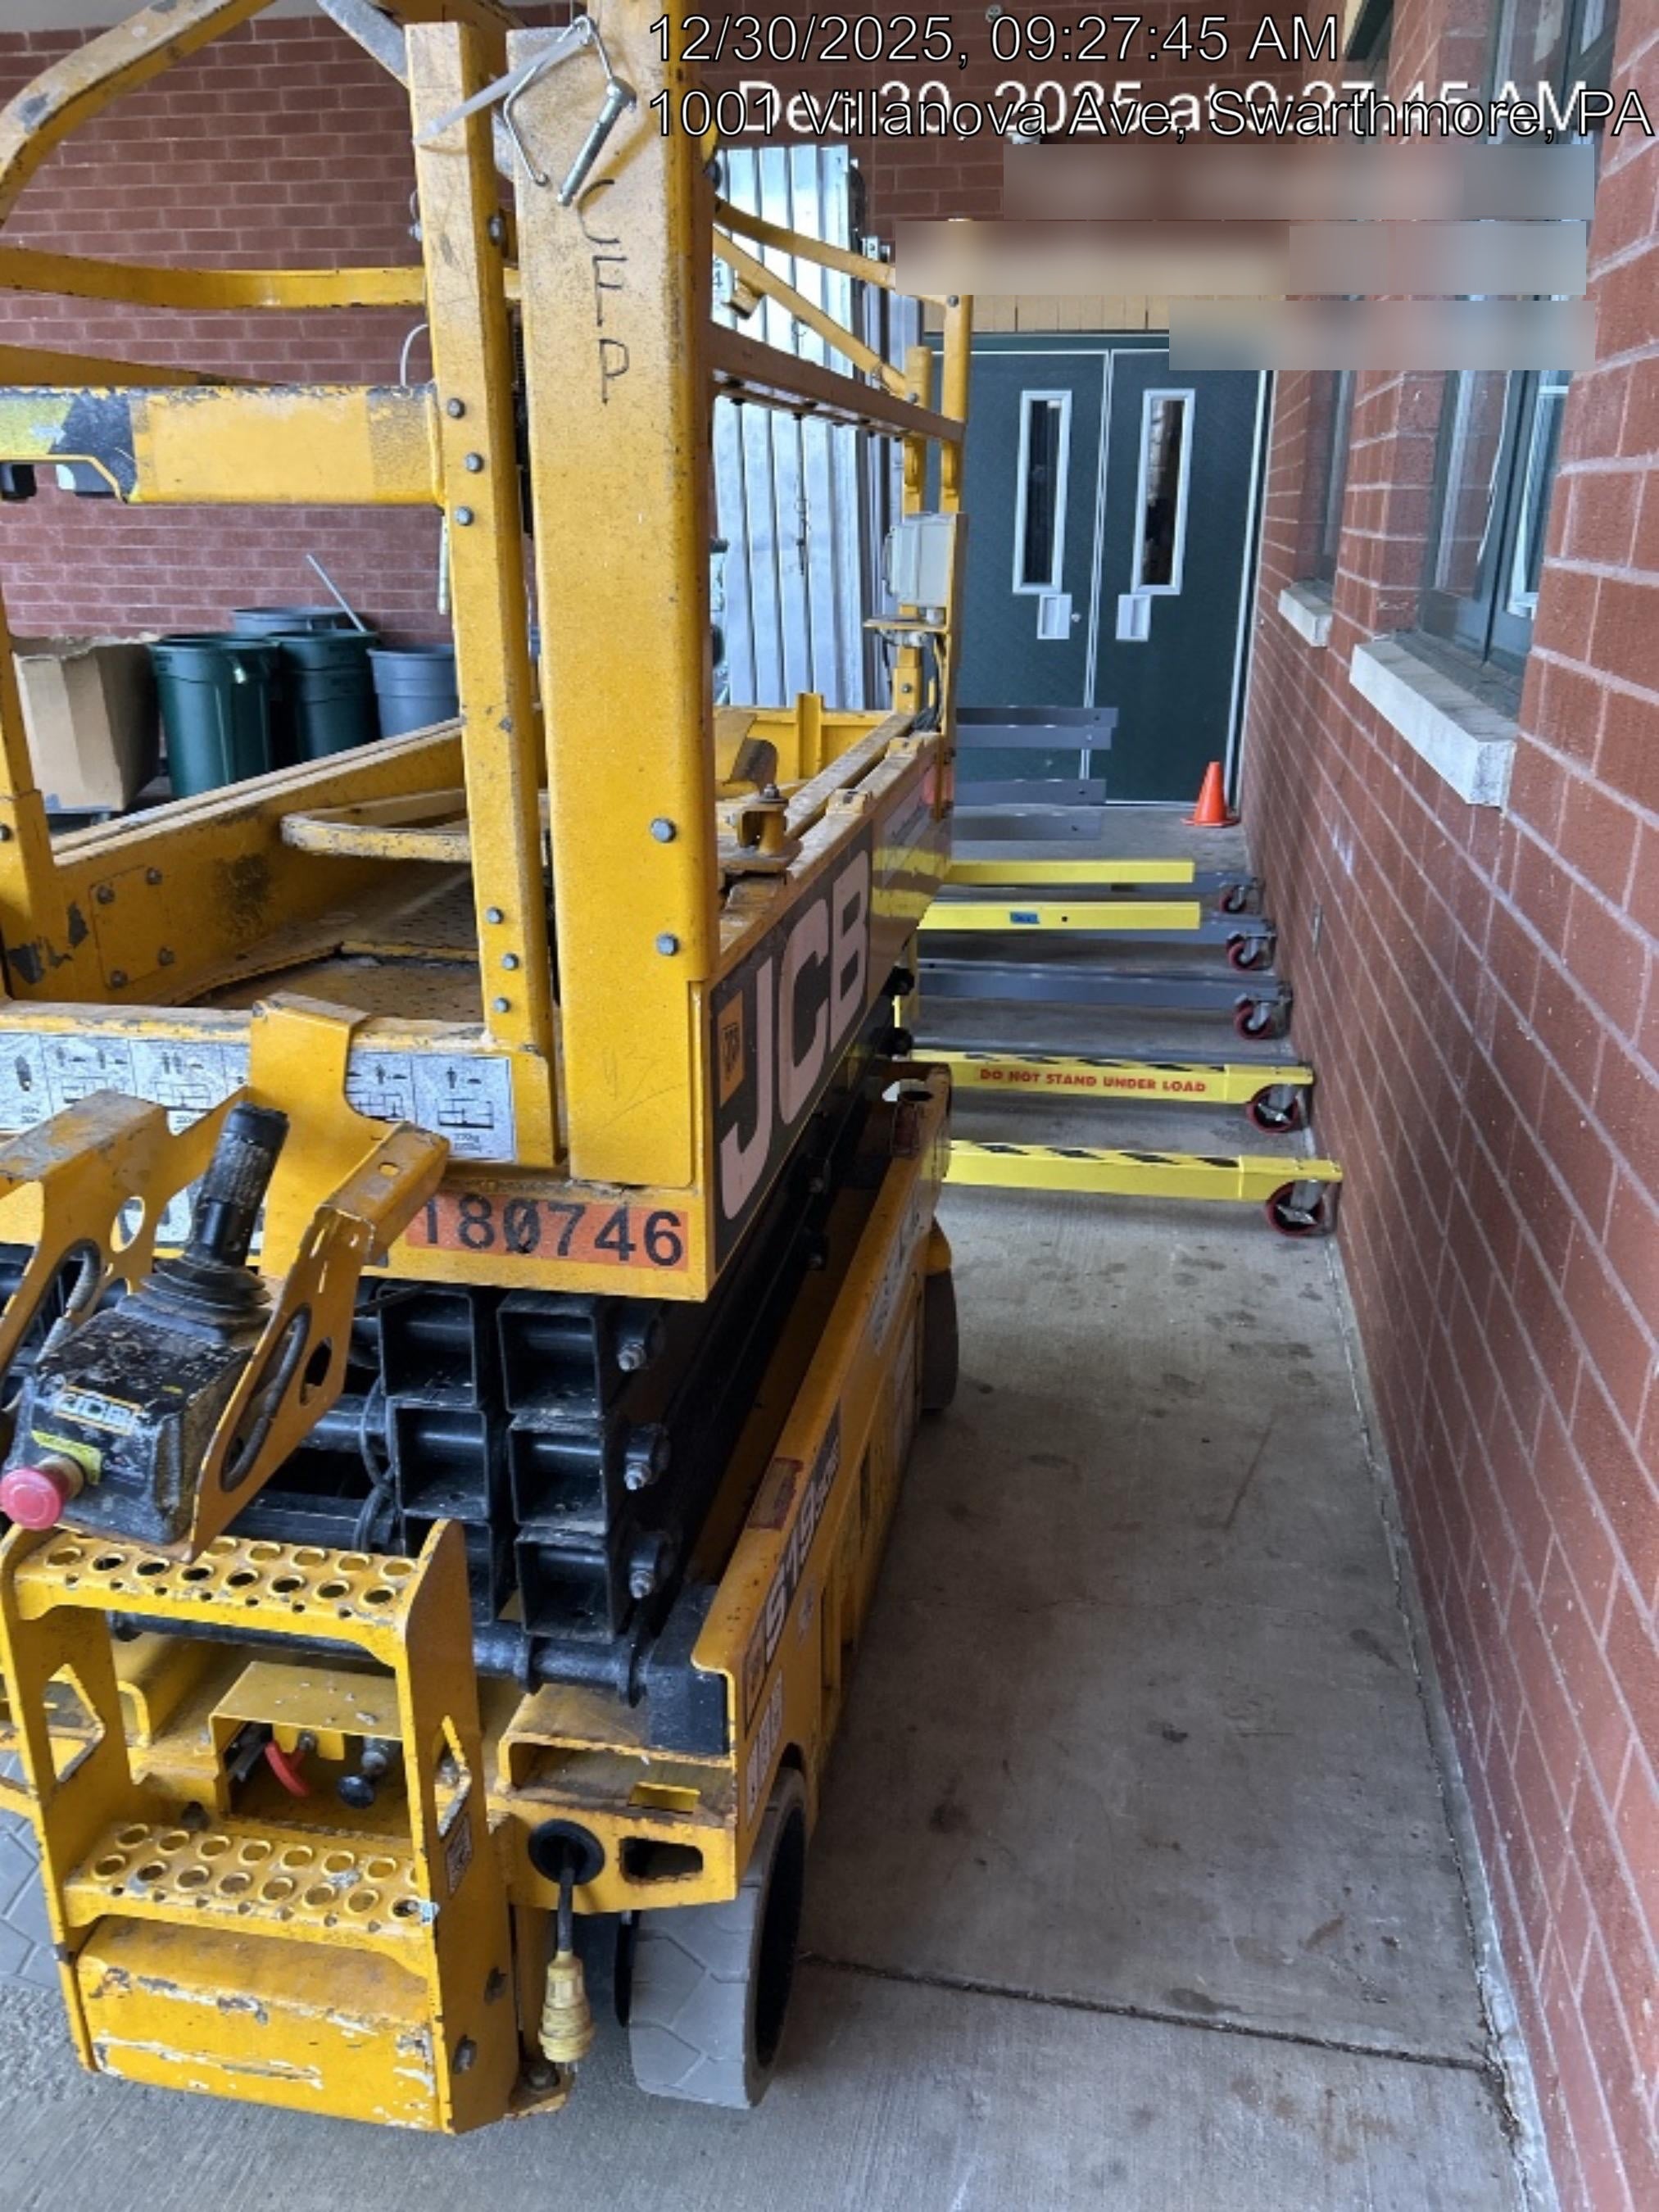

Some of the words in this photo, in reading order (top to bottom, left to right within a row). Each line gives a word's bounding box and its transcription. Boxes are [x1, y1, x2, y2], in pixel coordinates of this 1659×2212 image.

[720, 849, 871, 1221] JCB
[980, 1068, 1004, 1081] DO
[1009, 1071, 1041, 1083] NOT
[1045, 1073, 1097, 1088] STAND
[1103, 1077, 1156, 1090] UNDER
[1162, 1080, 1207, 1093] LOAD
[423, 1193, 684, 1267] 180746
